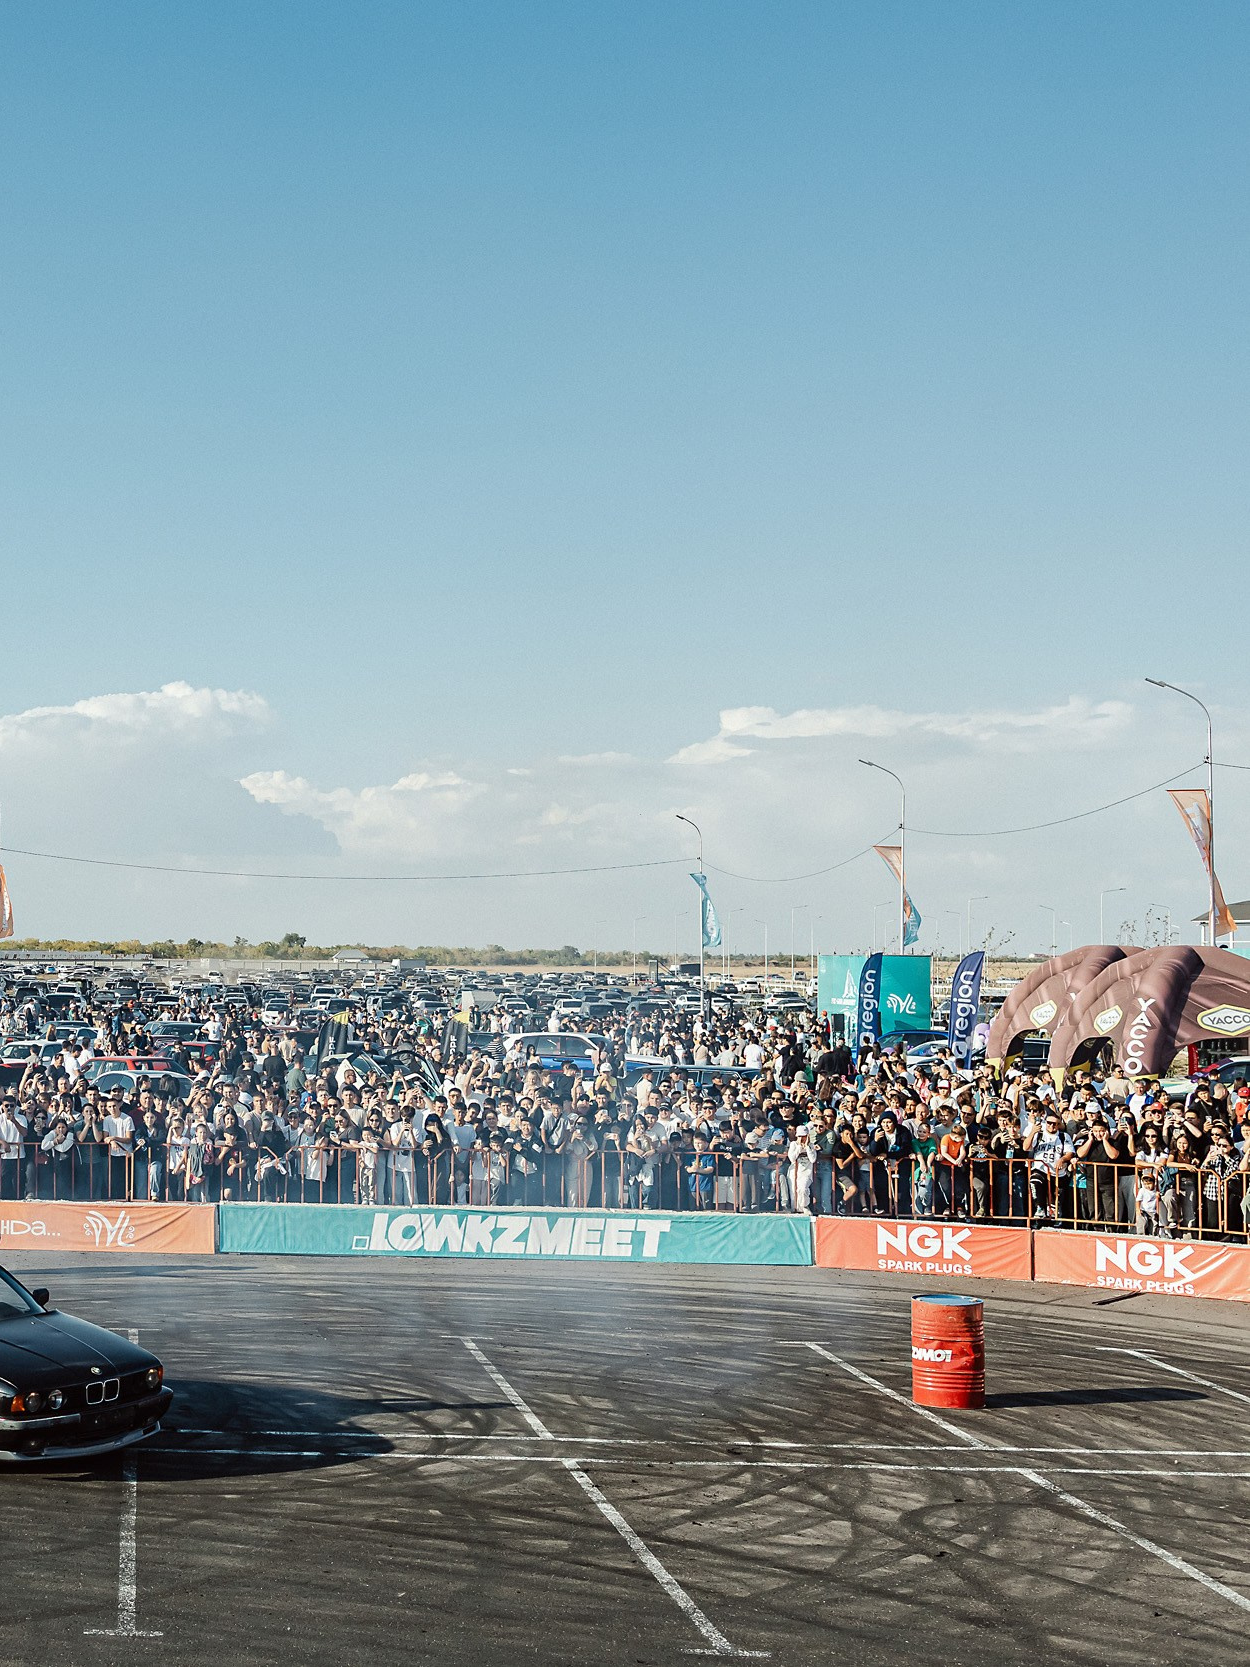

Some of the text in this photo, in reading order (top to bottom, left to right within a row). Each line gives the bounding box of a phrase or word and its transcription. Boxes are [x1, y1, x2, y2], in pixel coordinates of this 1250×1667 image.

[860, 969, 878, 1031] region
[953, 970, 976, 1037] region
[1124, 998, 1155, 1074] YACCO
[876, 1223, 973, 1262] NGK
[1095, 1239, 1195, 1279] NGK
[878, 1259, 972, 1275] SPARK PLUGS
[1097, 1275, 1195, 1295] SPARK PLUGS
